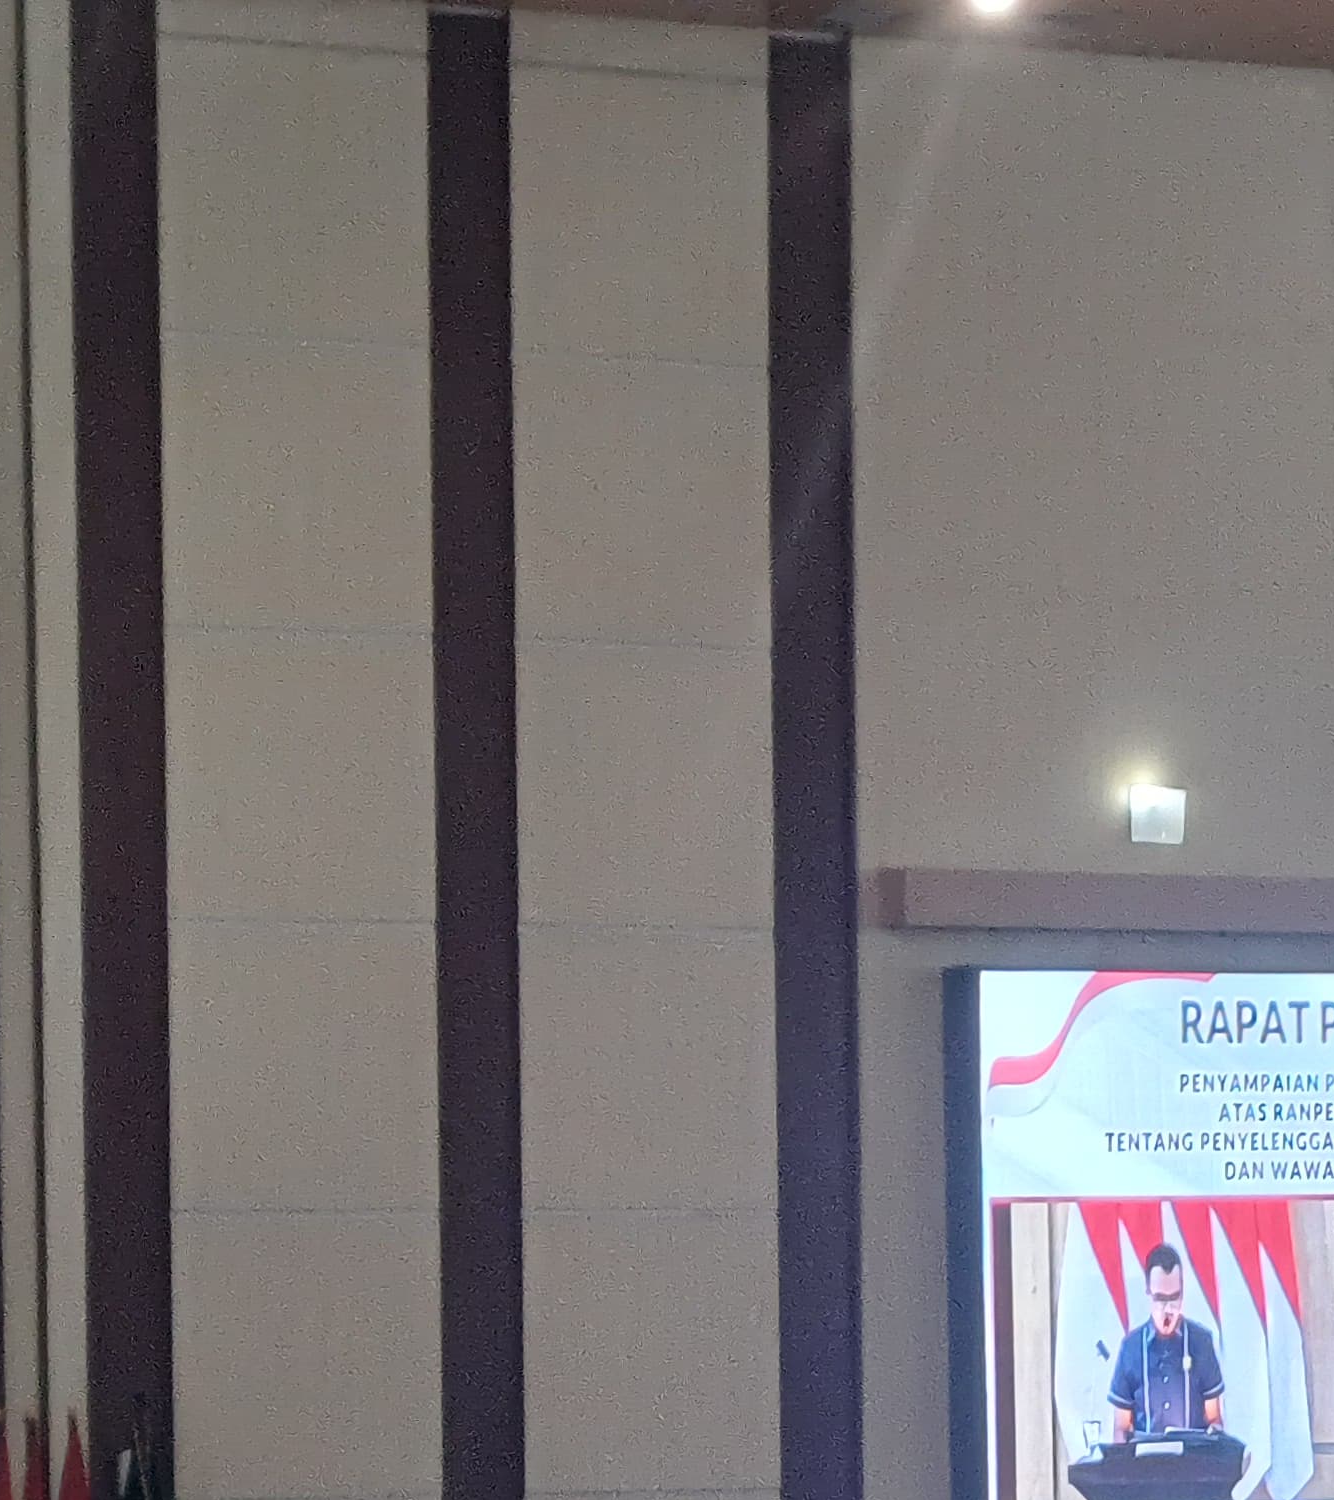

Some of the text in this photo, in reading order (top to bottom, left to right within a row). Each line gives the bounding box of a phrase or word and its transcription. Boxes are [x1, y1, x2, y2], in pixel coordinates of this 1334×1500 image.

[1181, 1000, 1310, 1044] RAPAT
[1179, 1072, 1319, 1093] PENYAMPAIAN
[1218, 1102, 1267, 1123] ATAS
[1104, 1131, 1194, 1153] TENTANG
[1224, 1160, 1264, 1181] DAN
